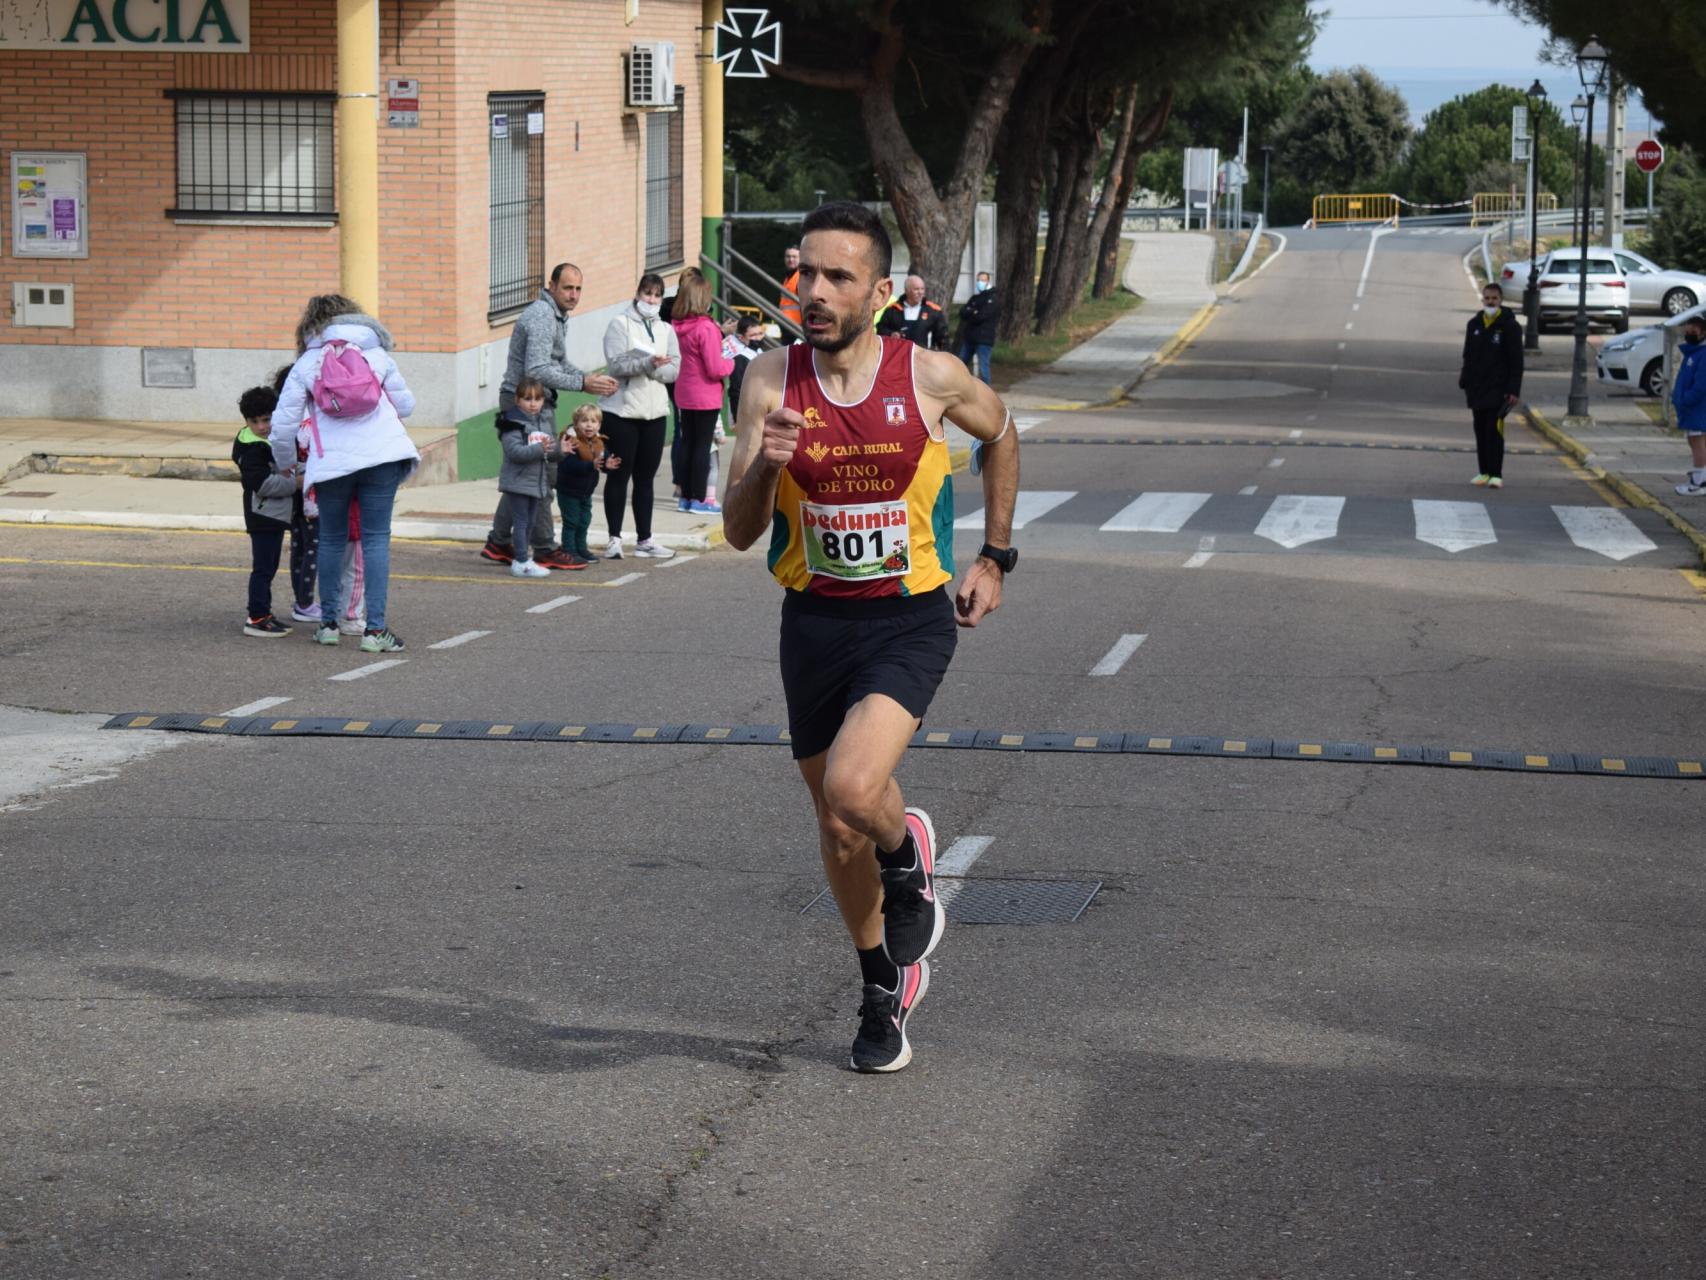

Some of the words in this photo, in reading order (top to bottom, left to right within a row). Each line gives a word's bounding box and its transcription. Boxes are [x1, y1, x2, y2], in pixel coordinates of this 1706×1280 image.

[1637, 151, 1660, 160] STOP
[832, 445, 861, 457] CAJA
[863, 442, 904, 455] RURAL
[832, 464, 878, 478] VINO
[817, 481, 841, 493] DE
[844, 478, 895, 493] TORO
[802, 506, 907, 532] bedunia
[822, 530, 884, 562] 801
